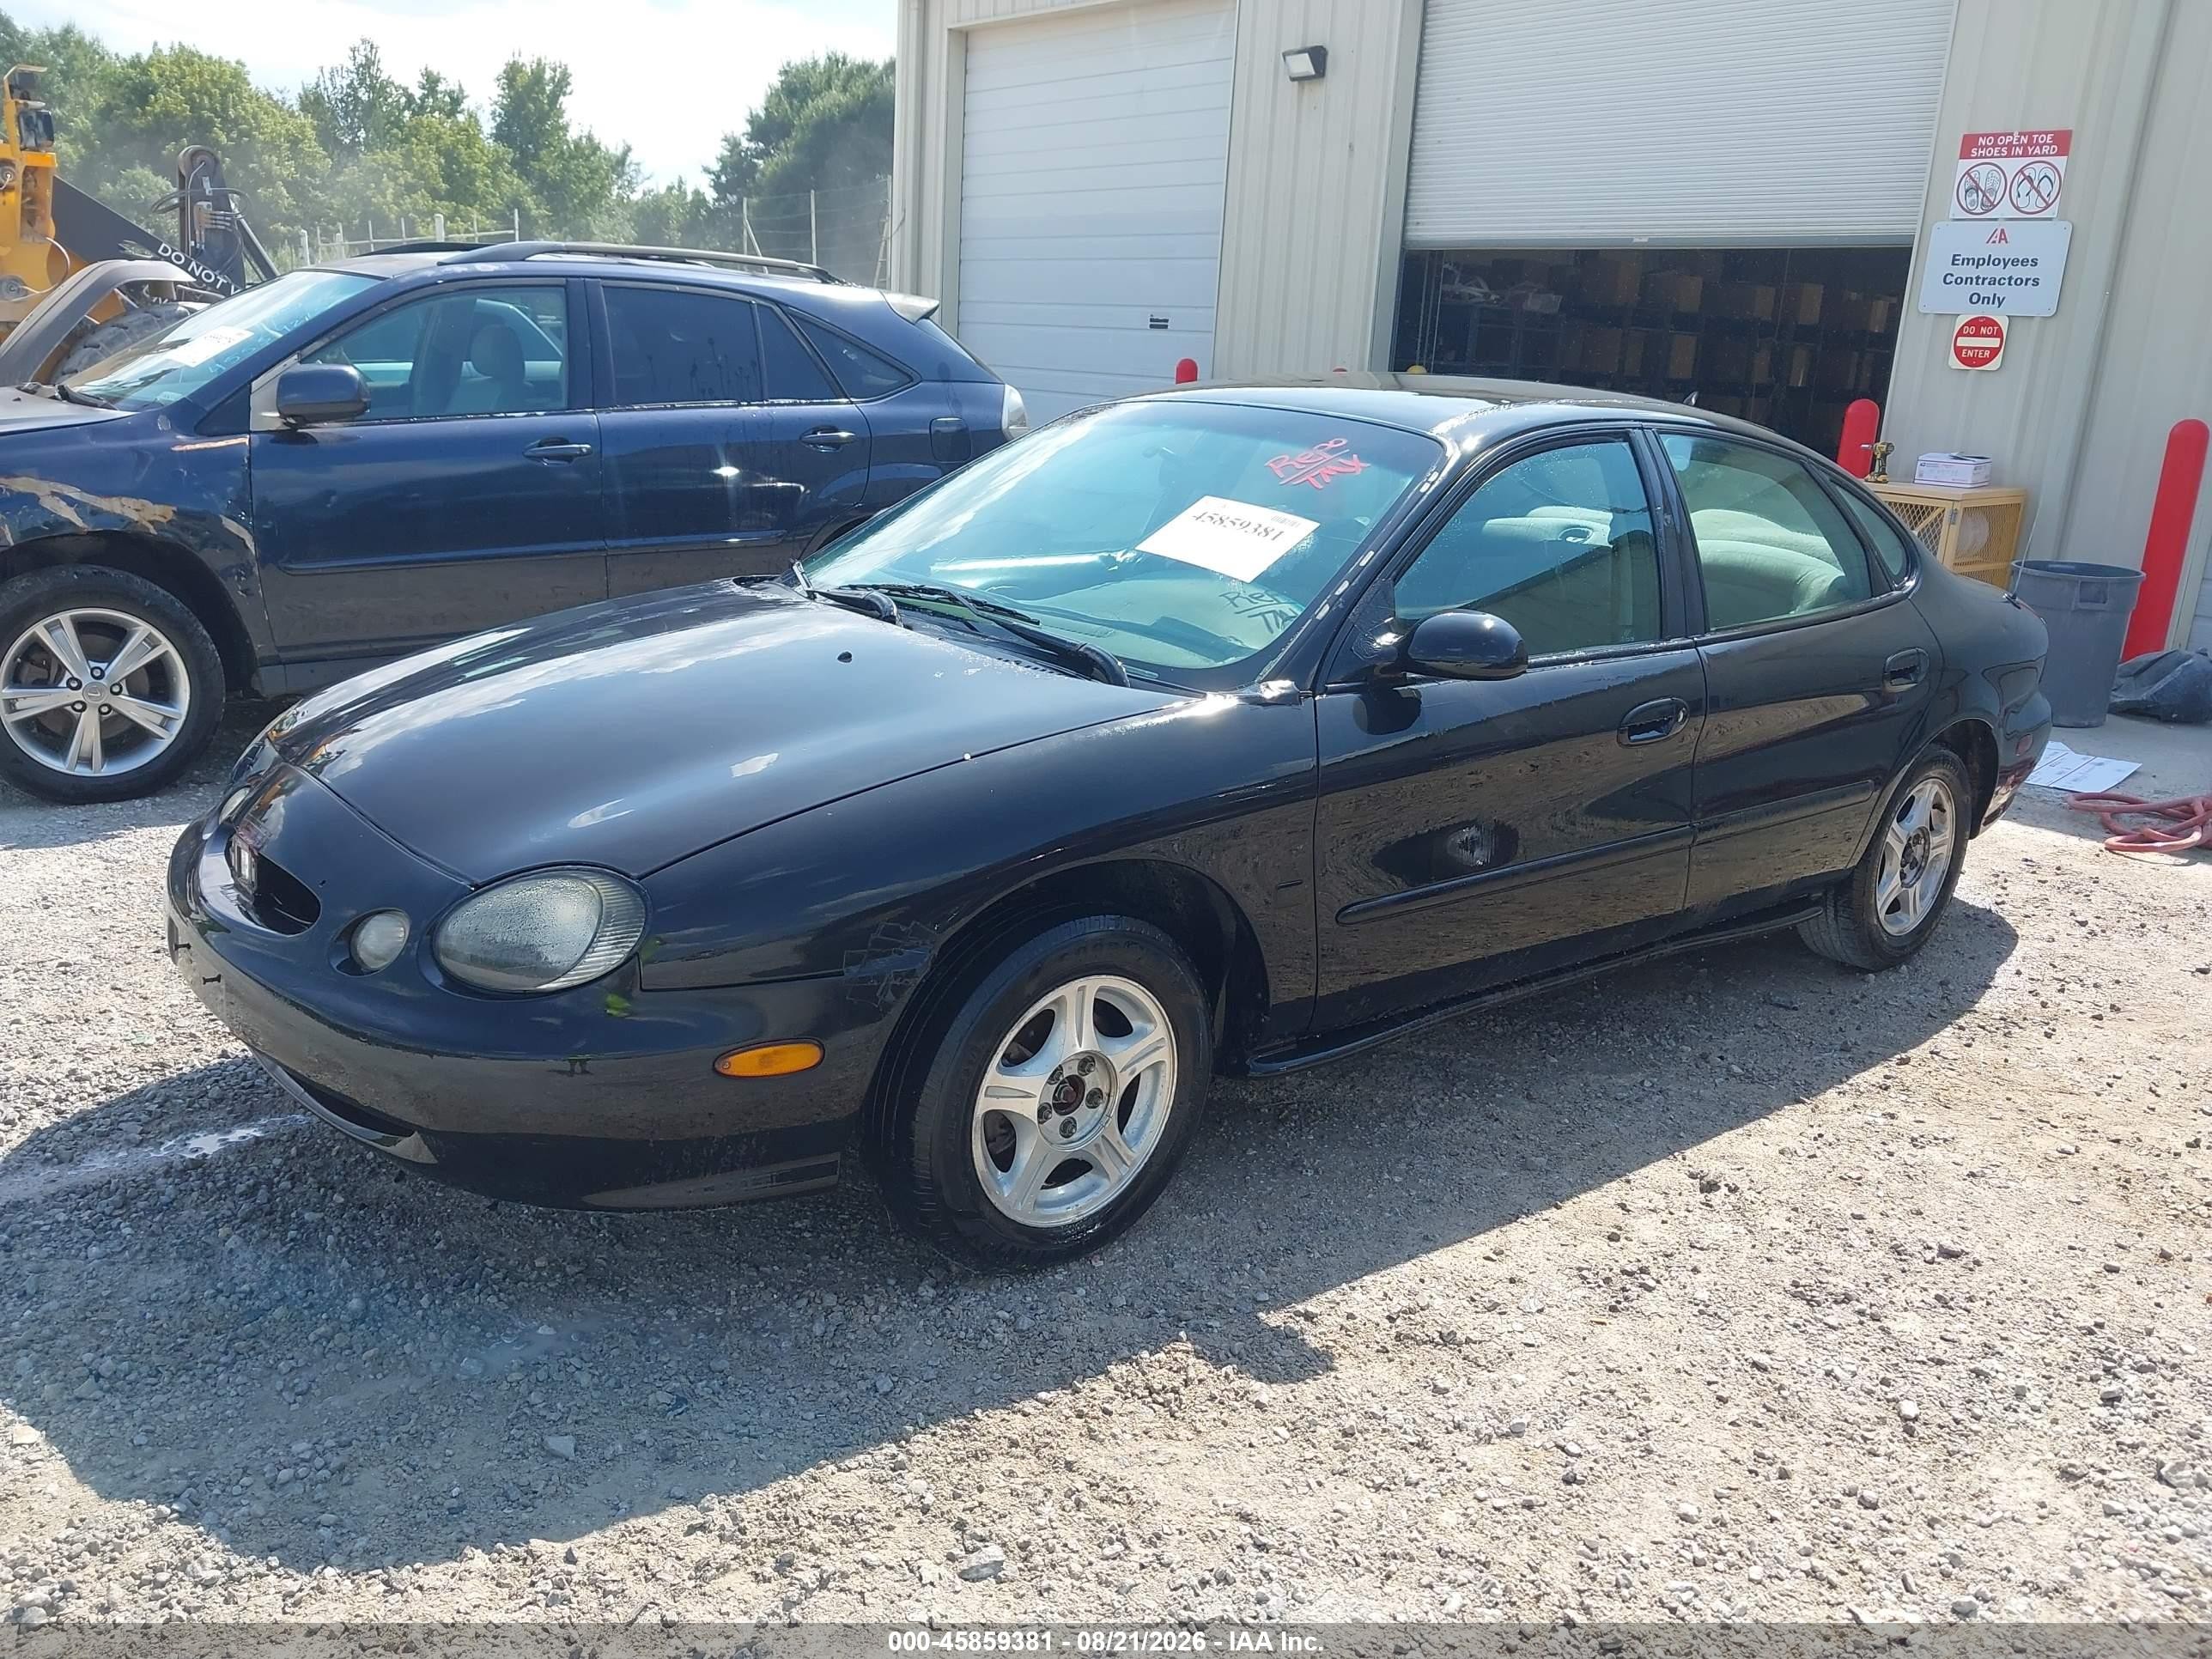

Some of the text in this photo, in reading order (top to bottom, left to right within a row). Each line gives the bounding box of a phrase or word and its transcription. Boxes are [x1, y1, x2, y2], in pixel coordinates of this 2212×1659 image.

[1978, 134, 2054, 146] NO OPEN TOE
[1971, 145, 2058, 157] SHOES IN YARD
[158, 243, 228, 289] DO NOT
[1951, 253, 2039, 270] Employees
[1942, 272, 2040, 287] Contractors
[1968, 292, 2006, 308] Only
[1963, 325, 1999, 336] DO NOT
[1961, 349, 1990, 358] ENTER
[1192, 511, 1285, 541] 45859381
